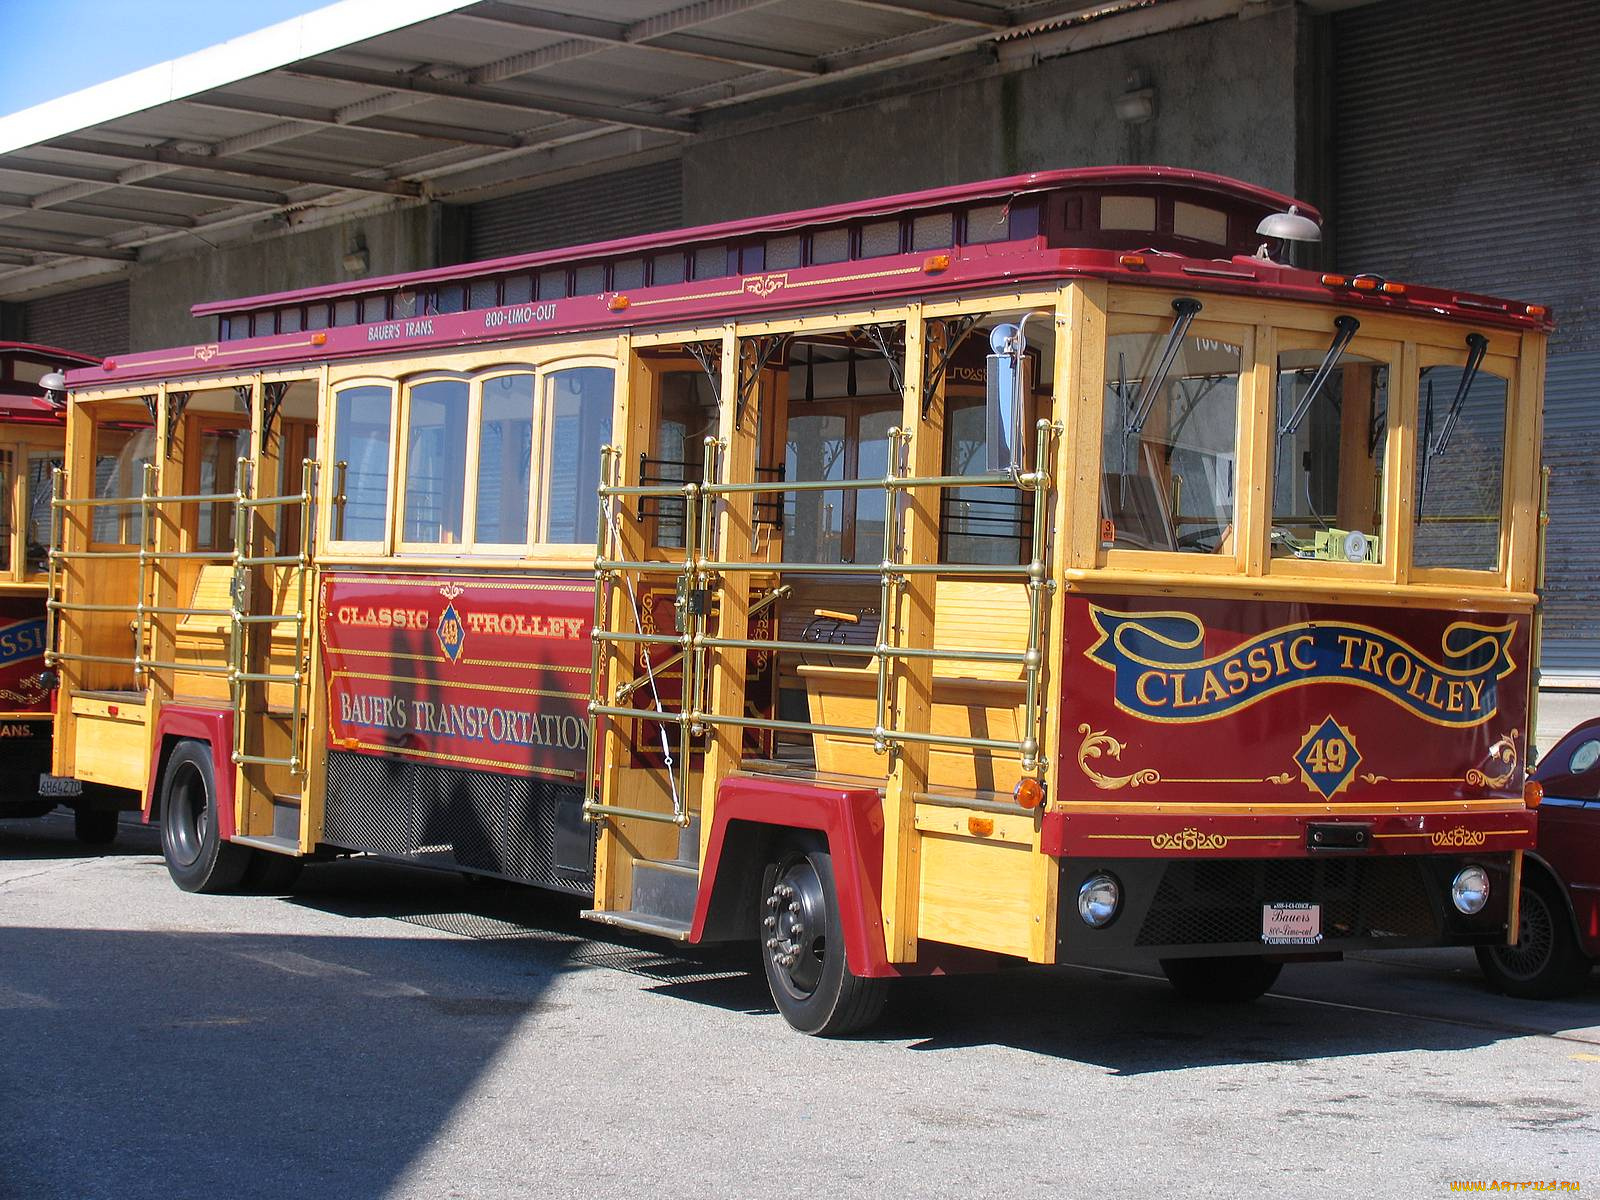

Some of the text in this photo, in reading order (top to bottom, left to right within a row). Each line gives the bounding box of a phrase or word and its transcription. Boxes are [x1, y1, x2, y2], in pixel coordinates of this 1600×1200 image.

[368, 320, 434, 342] BAUER'S TRANS.
[485, 304, 557, 327] 800-LIMO-OUT
[338, 606, 585, 640] CLASSIC TROLLEY
[1135, 634, 1486, 713] CLASSIC TROLLEY
[340, 692, 590, 750] BAUER'S TRANSPORTATION
[1305, 737, 1348, 774] 49
